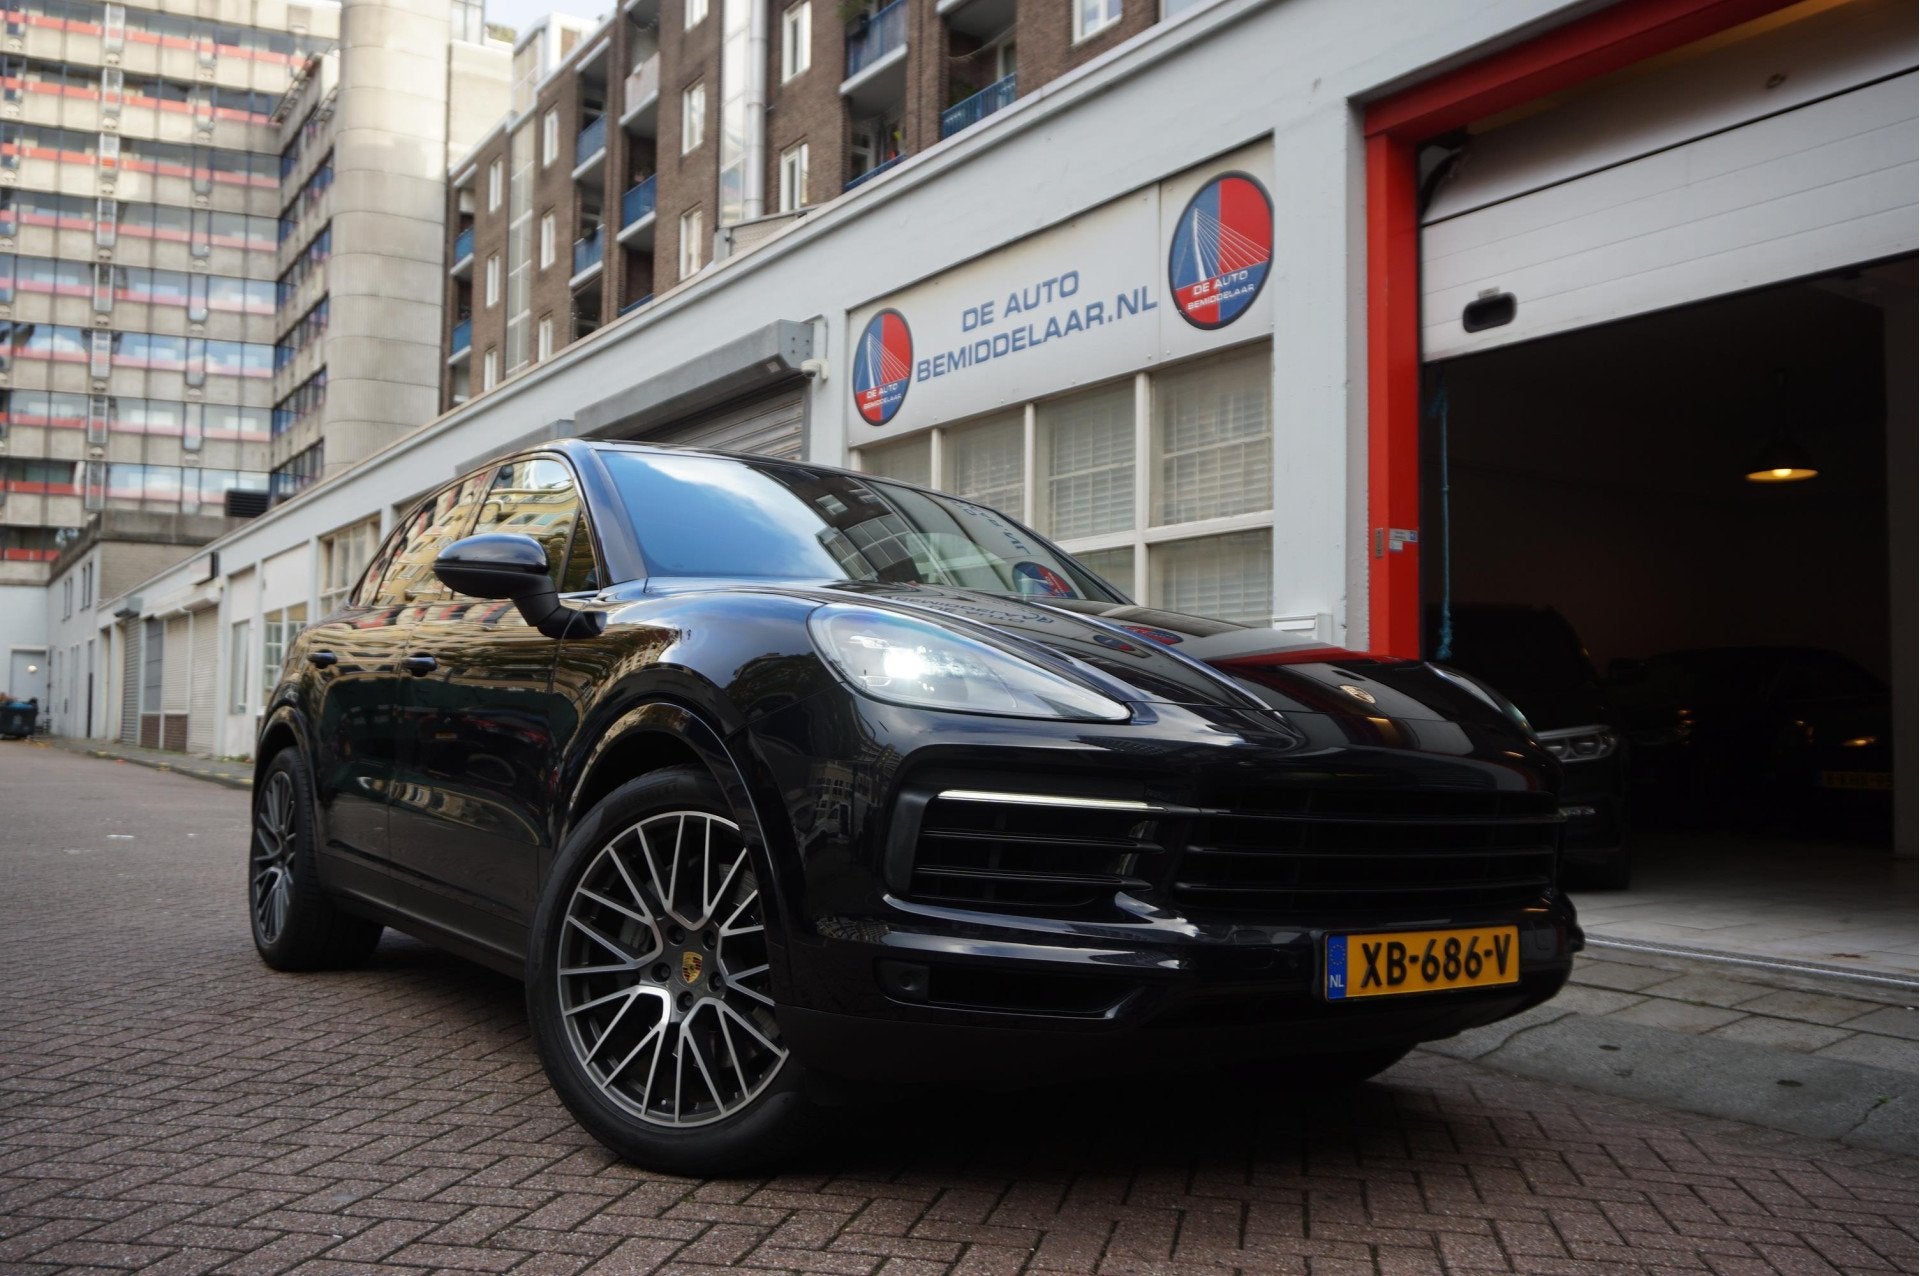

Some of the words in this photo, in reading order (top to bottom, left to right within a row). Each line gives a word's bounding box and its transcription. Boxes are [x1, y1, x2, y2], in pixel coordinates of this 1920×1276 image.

[962, 300, 995, 333] DE
[1003, 270, 1080, 319] AUTO
[1193, 281, 1210, 296] DE
[1213, 269, 1249, 289] AUTO
[916, 285, 1159, 383] BEMIDDELAAR.NL
[866, 389, 877, 399] DE
[1329, 974, 1345, 988] NL
[1360, 933, 1512, 989] XB-686-V
